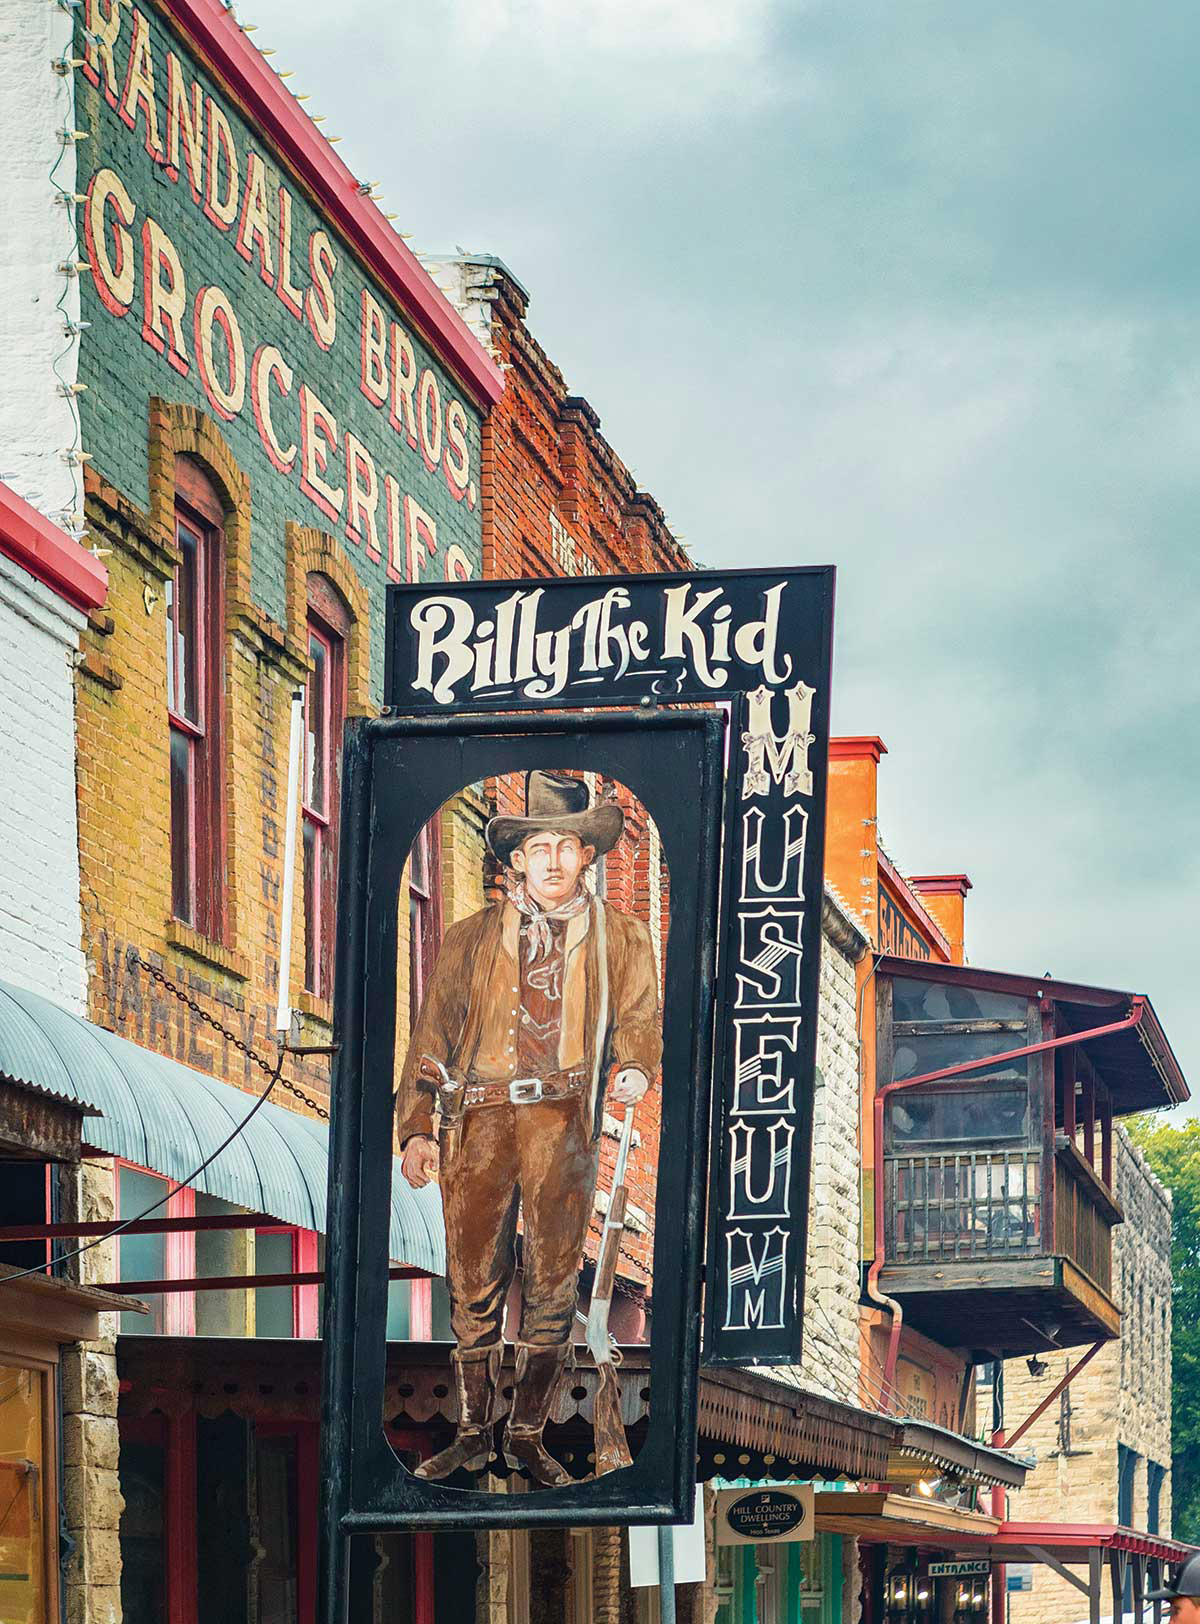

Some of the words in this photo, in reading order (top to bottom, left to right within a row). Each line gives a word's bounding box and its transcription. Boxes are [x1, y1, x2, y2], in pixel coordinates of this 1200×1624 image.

[410, 587, 572, 705] Billy
[571, 586, 651, 682] The
[660, 581, 793, 689] Kid
[721, 681, 816, 1331] MUSEUM
[733, 1507, 751, 1516] HILL
[755, 1504, 798, 1514] COUNTRY
[741, 1513, 791, 1523] DWELLINGS
[931, 1562, 988, 1575] ENTRANCE
